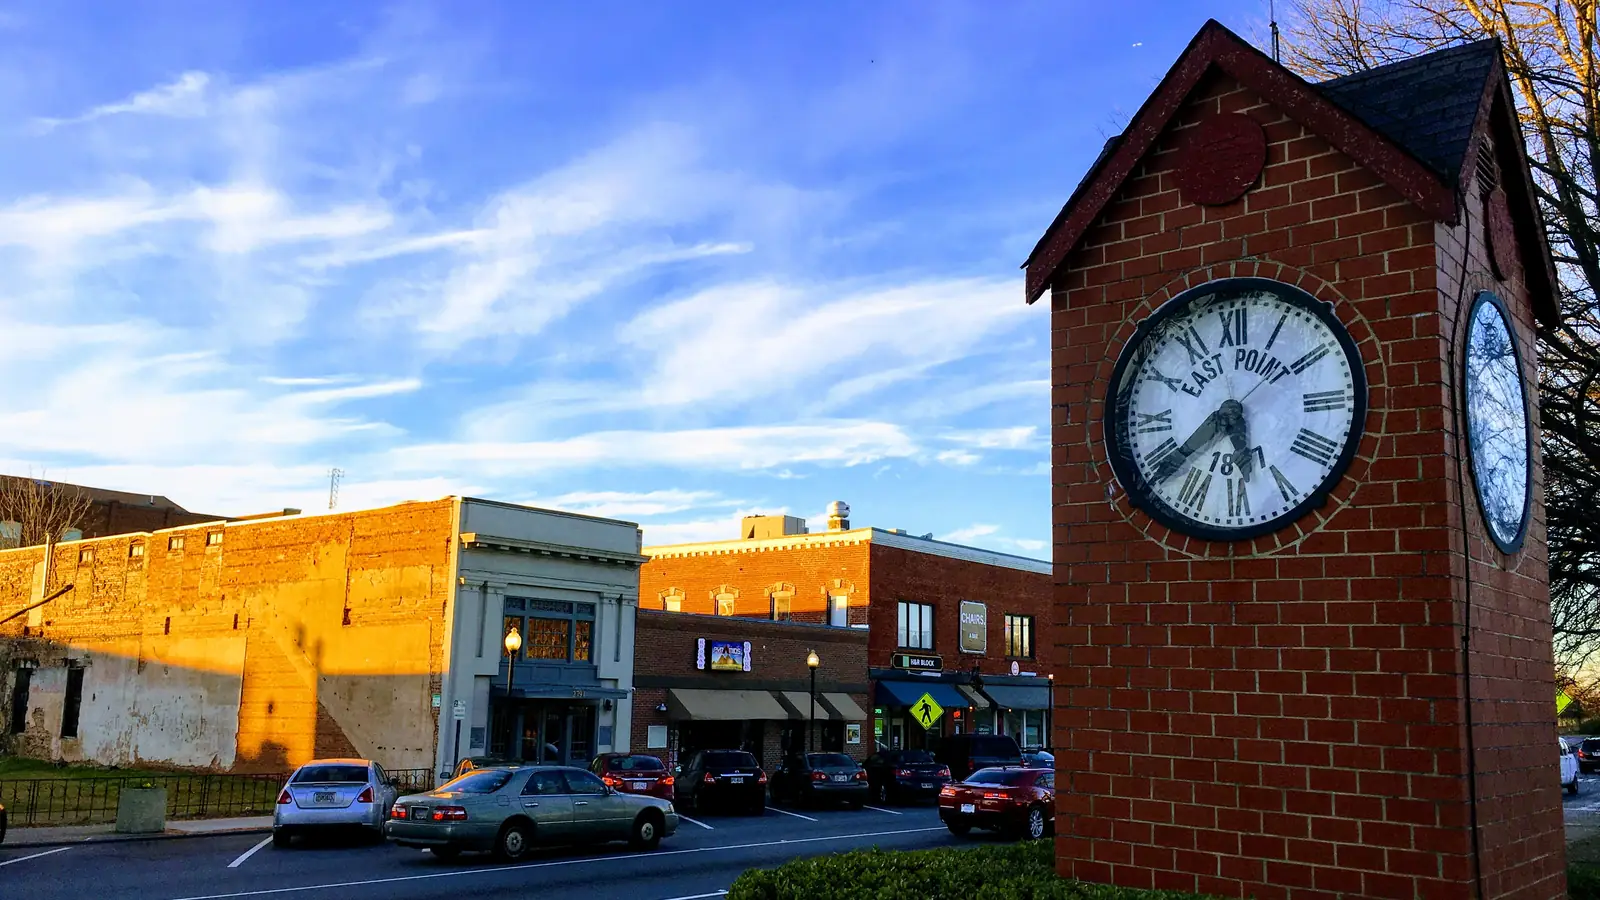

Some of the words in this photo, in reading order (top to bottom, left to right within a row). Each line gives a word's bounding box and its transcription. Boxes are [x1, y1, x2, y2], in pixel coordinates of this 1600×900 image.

[1176, 325, 1210, 366] XI
[1218, 307, 1248, 349] XII
[1146, 366, 1183, 393] X
[1180, 352, 1225, 398] EAST
[1234, 348, 1291, 385] POINT
[1208, 445, 1267, 476] 187
[1176, 466, 1213, 512] VII
[1226, 477, 1251, 518] VI
[1268, 464, 1300, 502] V
[920, 659, 935, 667] BLOCK
